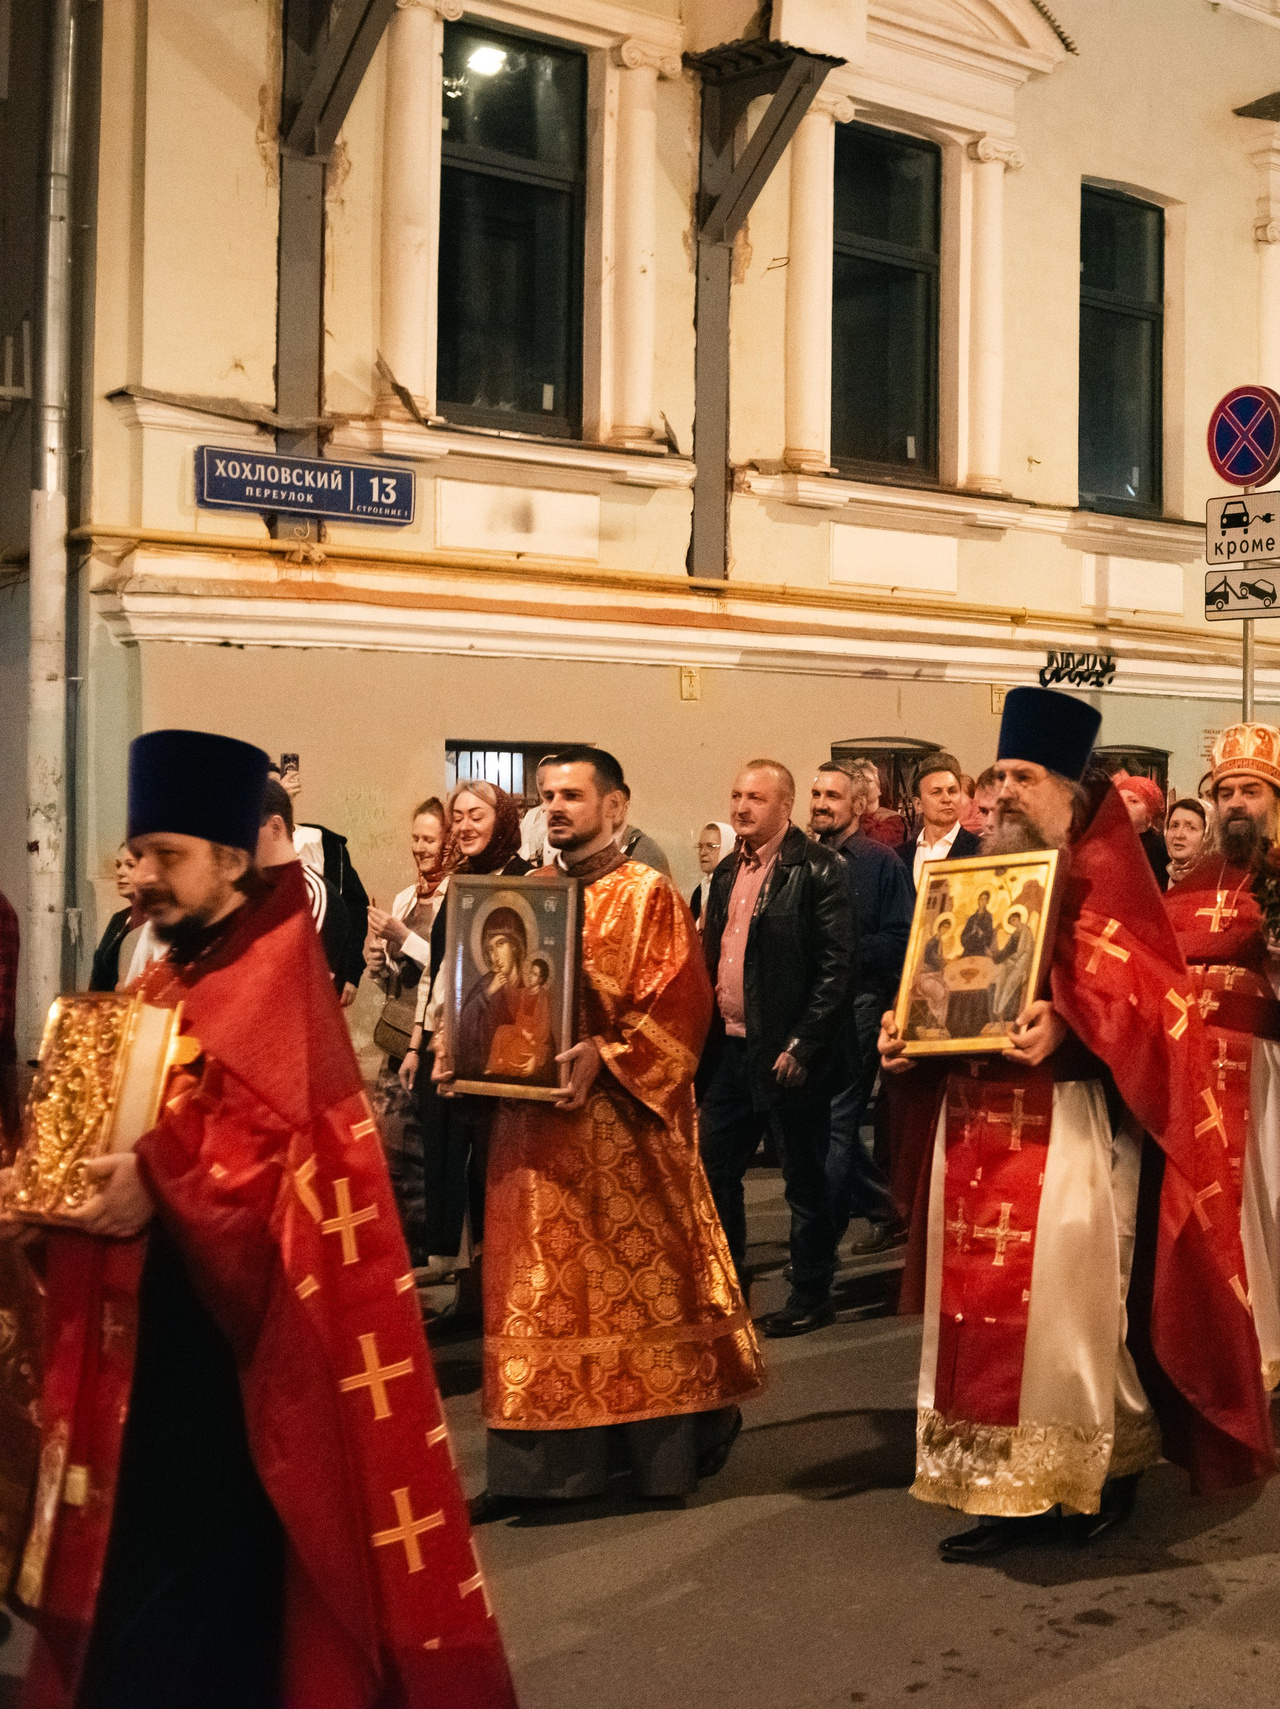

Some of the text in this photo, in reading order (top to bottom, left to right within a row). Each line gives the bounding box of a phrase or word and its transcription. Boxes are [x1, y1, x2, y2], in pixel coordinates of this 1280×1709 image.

[214, 459, 343, 491] ХОХЛОВСКИЙ
[245, 486, 314, 503] ПЕРЕУЛОК
[369, 476, 398, 505] 13
[356, 504, 402, 517] СТРОЕНИЕ
[1214, 537, 1276, 559] кроме
